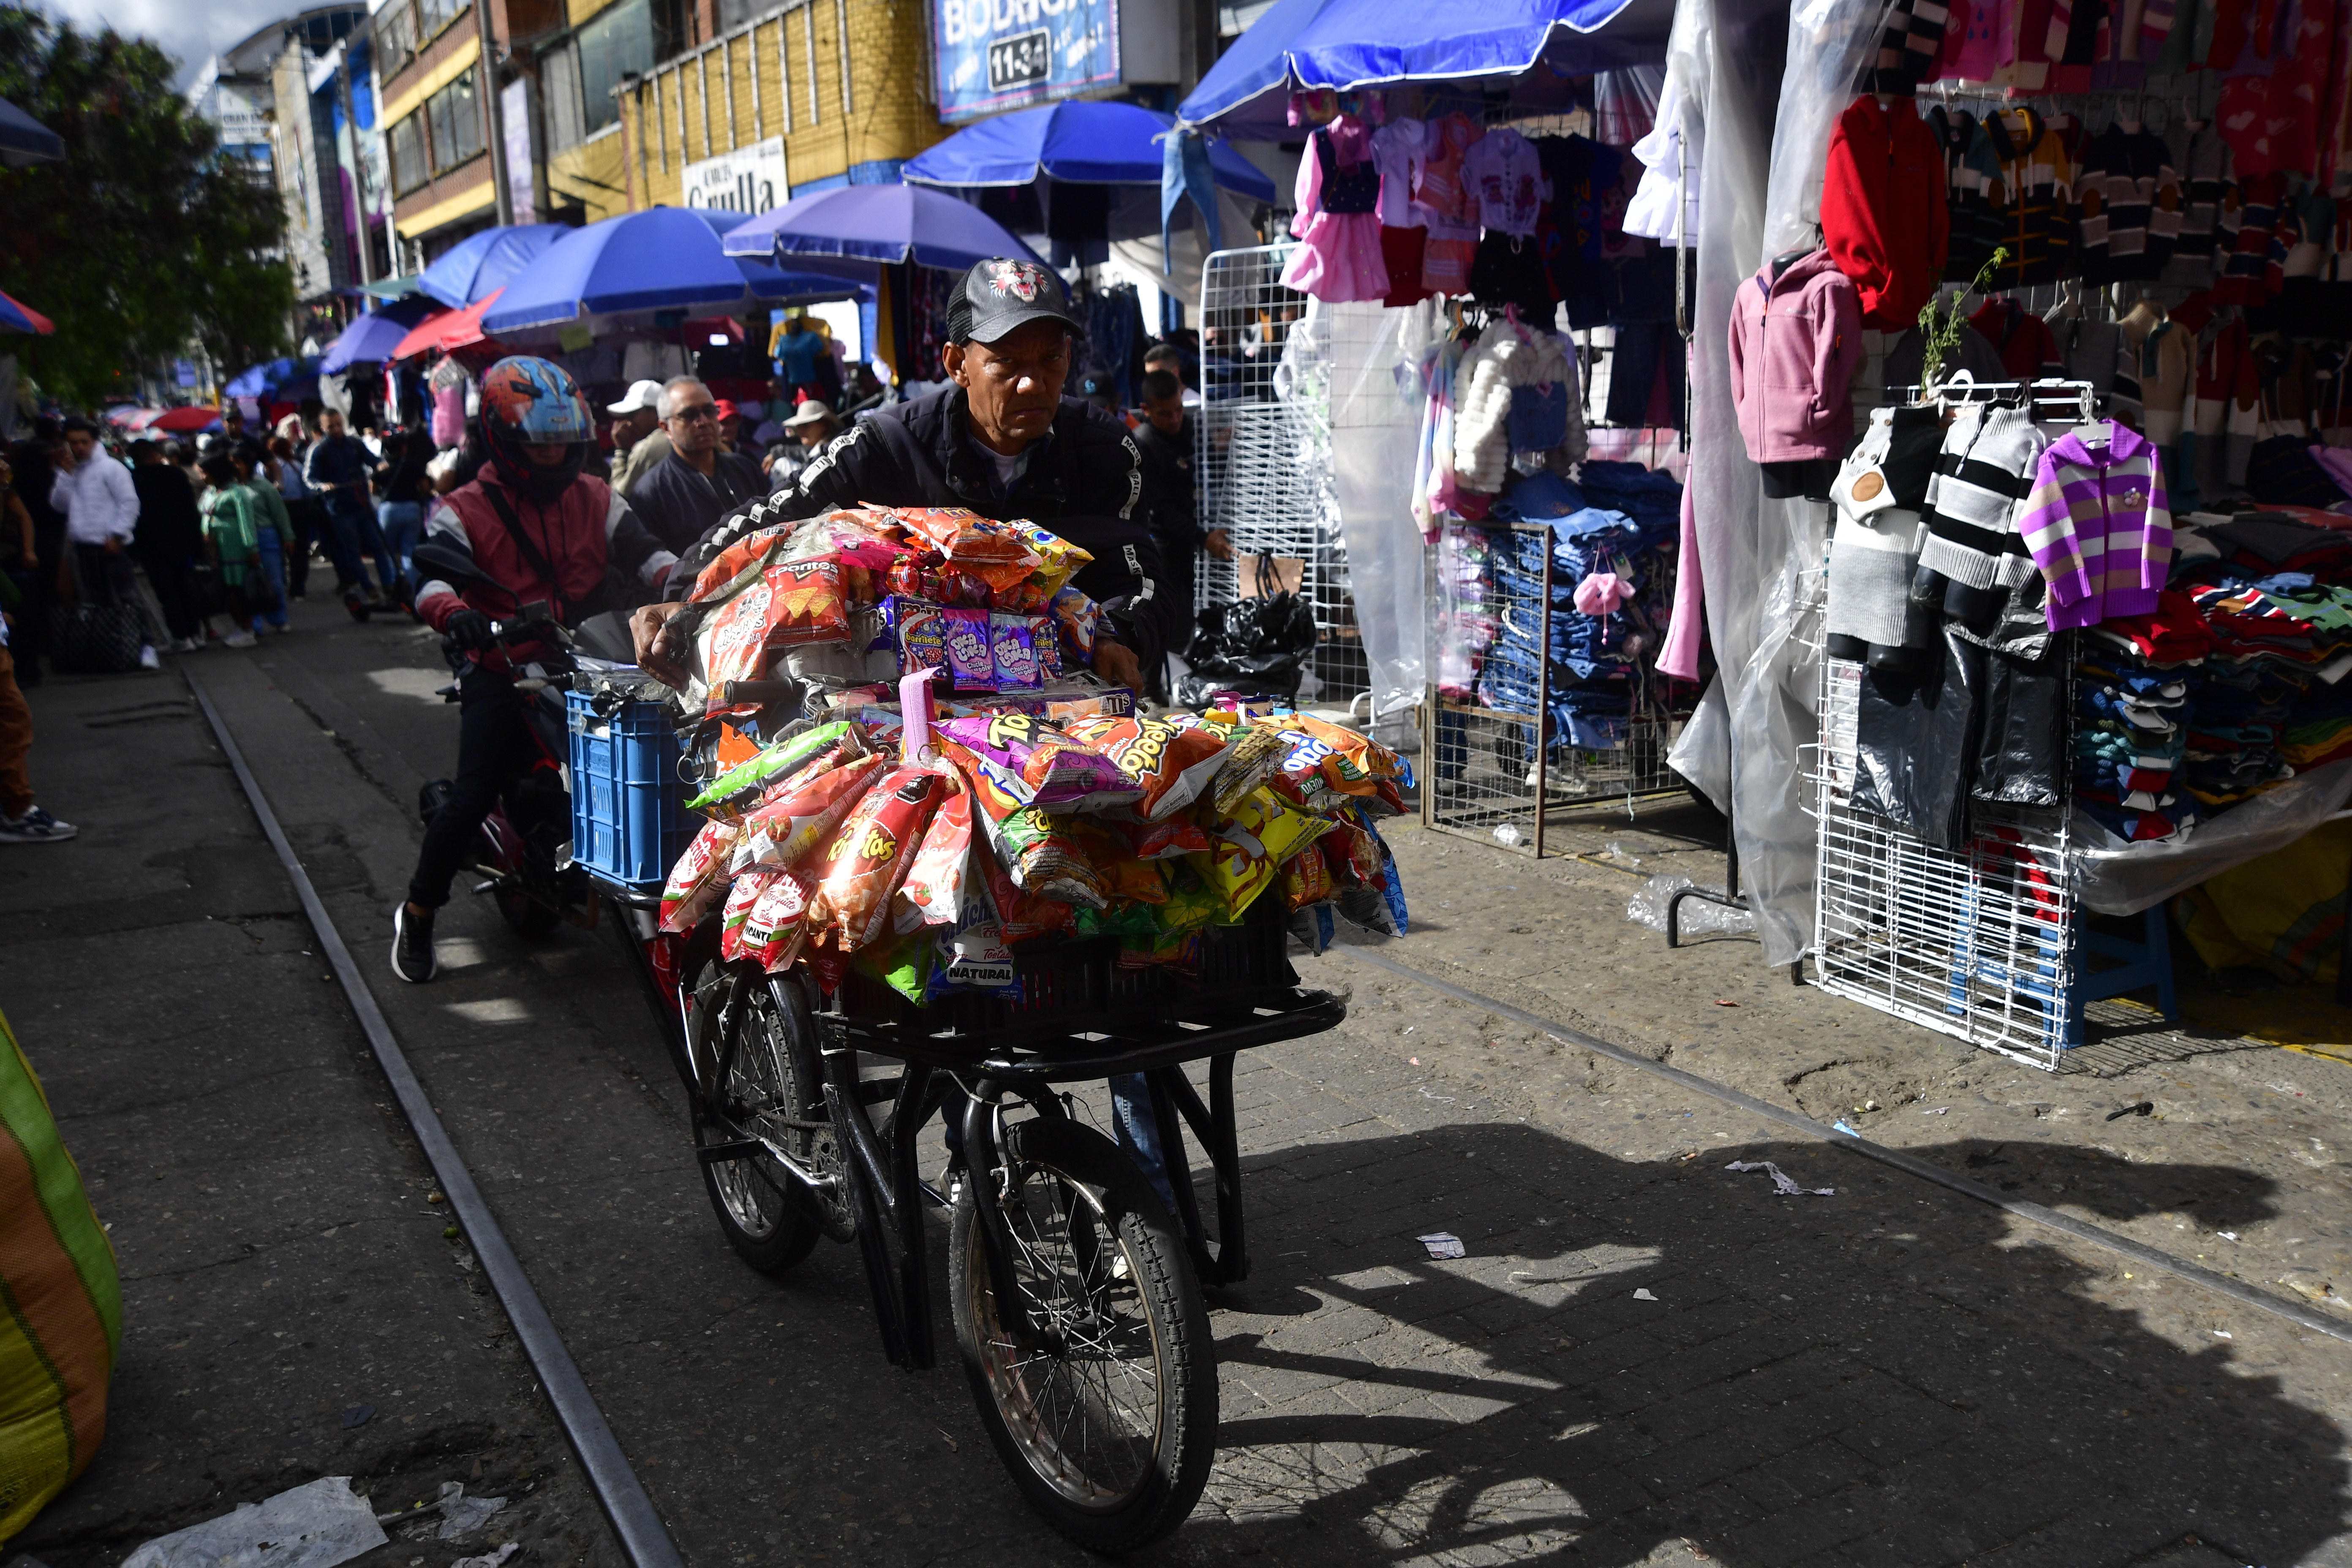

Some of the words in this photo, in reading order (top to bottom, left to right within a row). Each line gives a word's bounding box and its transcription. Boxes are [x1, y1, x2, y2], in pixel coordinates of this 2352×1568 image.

[1130, 474, 1139, 497] BALL
[775, 561, 838, 577] Doritos
[905, 632, 942, 646] barrilete
[950, 633, 977, 650] OKA
[994, 638, 1020, 656] OKA
[956, 644, 986, 662] LOKA
[999, 648, 1031, 667] LOKA
[966, 661, 984, 670] Chicle
[1009, 664, 1029, 674] Chicle
[1024, 666, 1038, 677] polvo
[1301, 776, 1324, 795] NUEVO
[949, 967, 1011, 980] NATURAL
